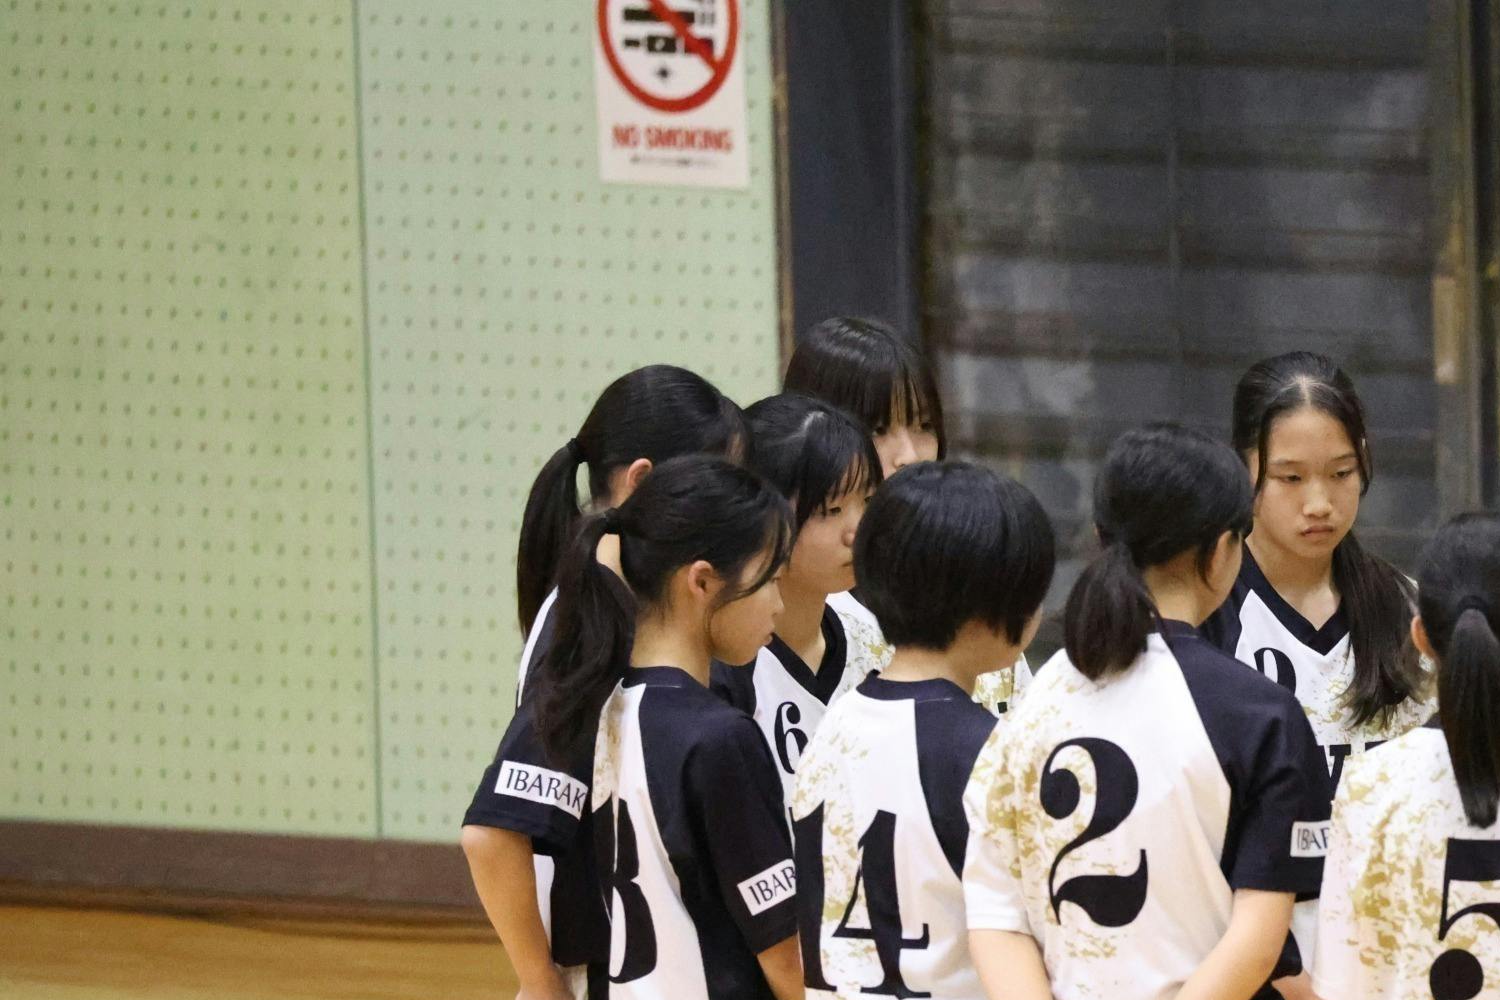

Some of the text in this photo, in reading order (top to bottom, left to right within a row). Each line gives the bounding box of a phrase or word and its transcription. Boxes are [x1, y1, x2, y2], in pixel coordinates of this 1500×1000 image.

[612, 125, 732, 152] NO SMOKING
[774, 701, 809, 775] 6
[1040, 736, 1148, 927] 2
[788, 799, 932, 1000] 14
